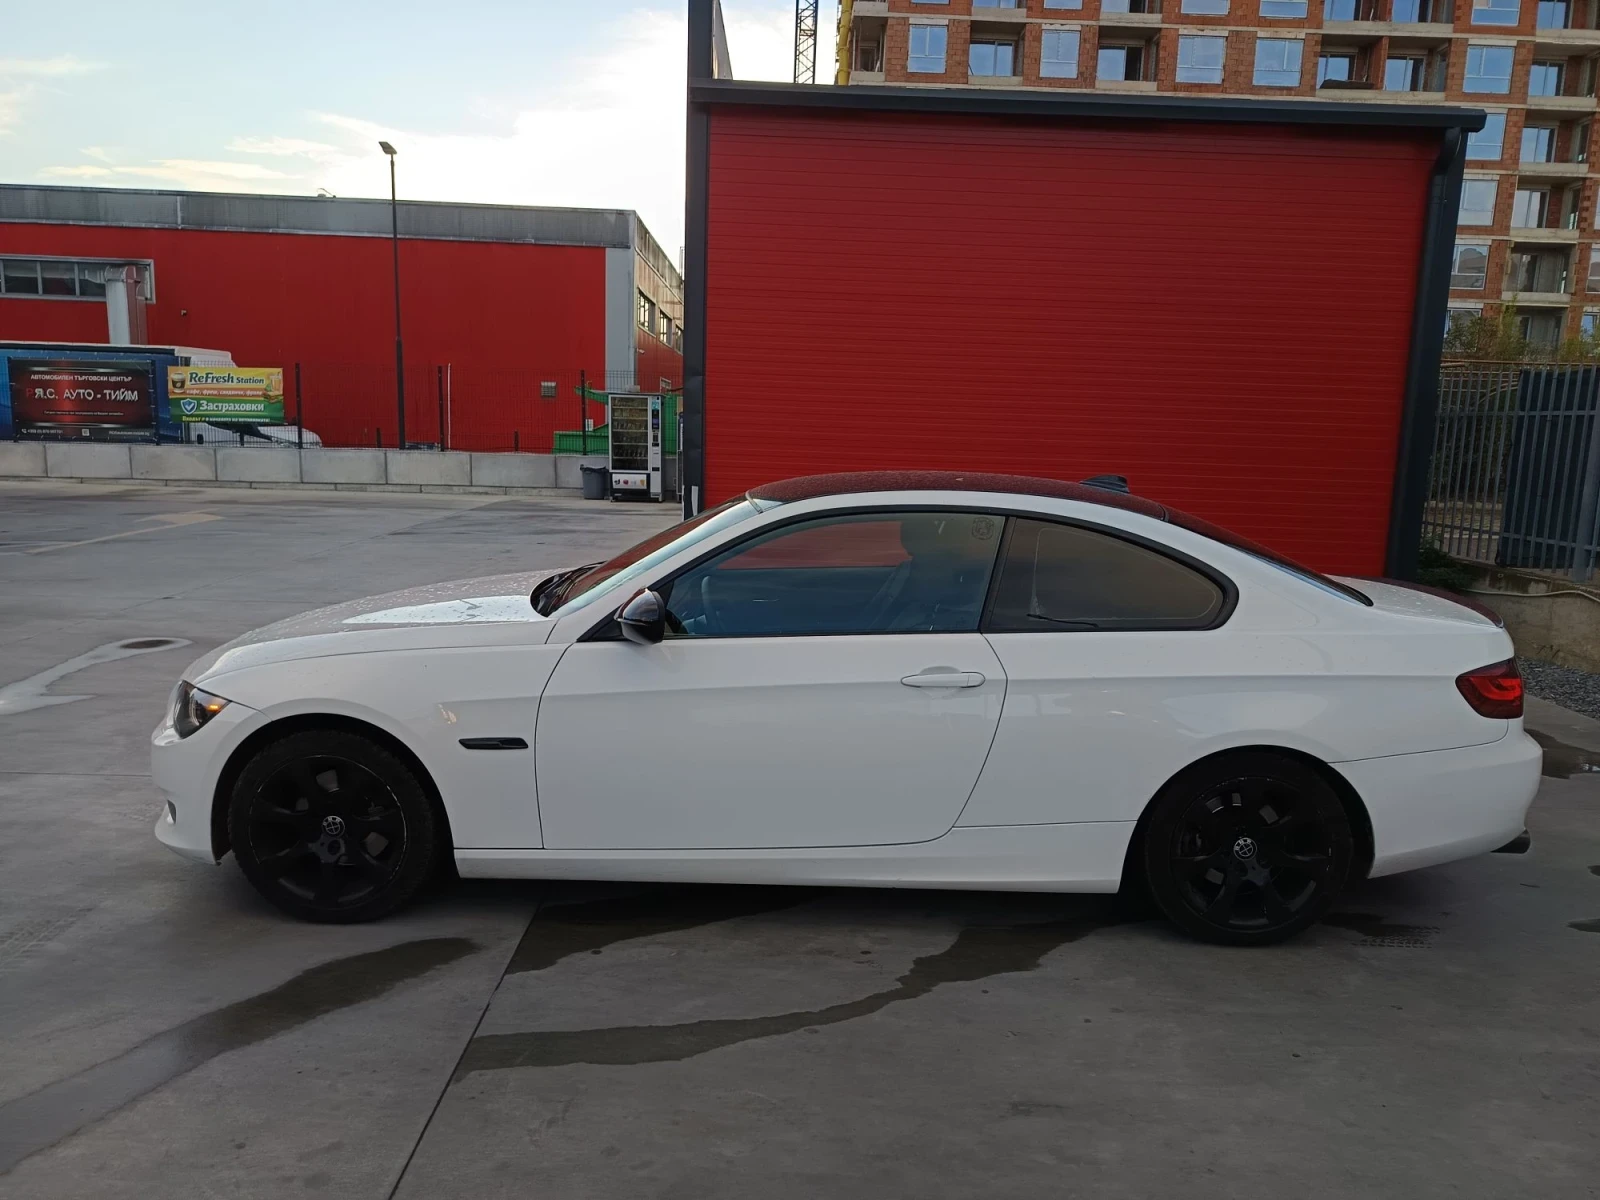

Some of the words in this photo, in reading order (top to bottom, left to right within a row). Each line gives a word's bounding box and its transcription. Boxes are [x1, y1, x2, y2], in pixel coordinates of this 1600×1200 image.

[189, 371, 234, 384] ReFresh
[236, 376, 264, 384] Station
[63, 389, 94, 400] АУТО
[104, 388, 138, 401] ТИЙМ
[200, 400, 264, 412] Застраховки
